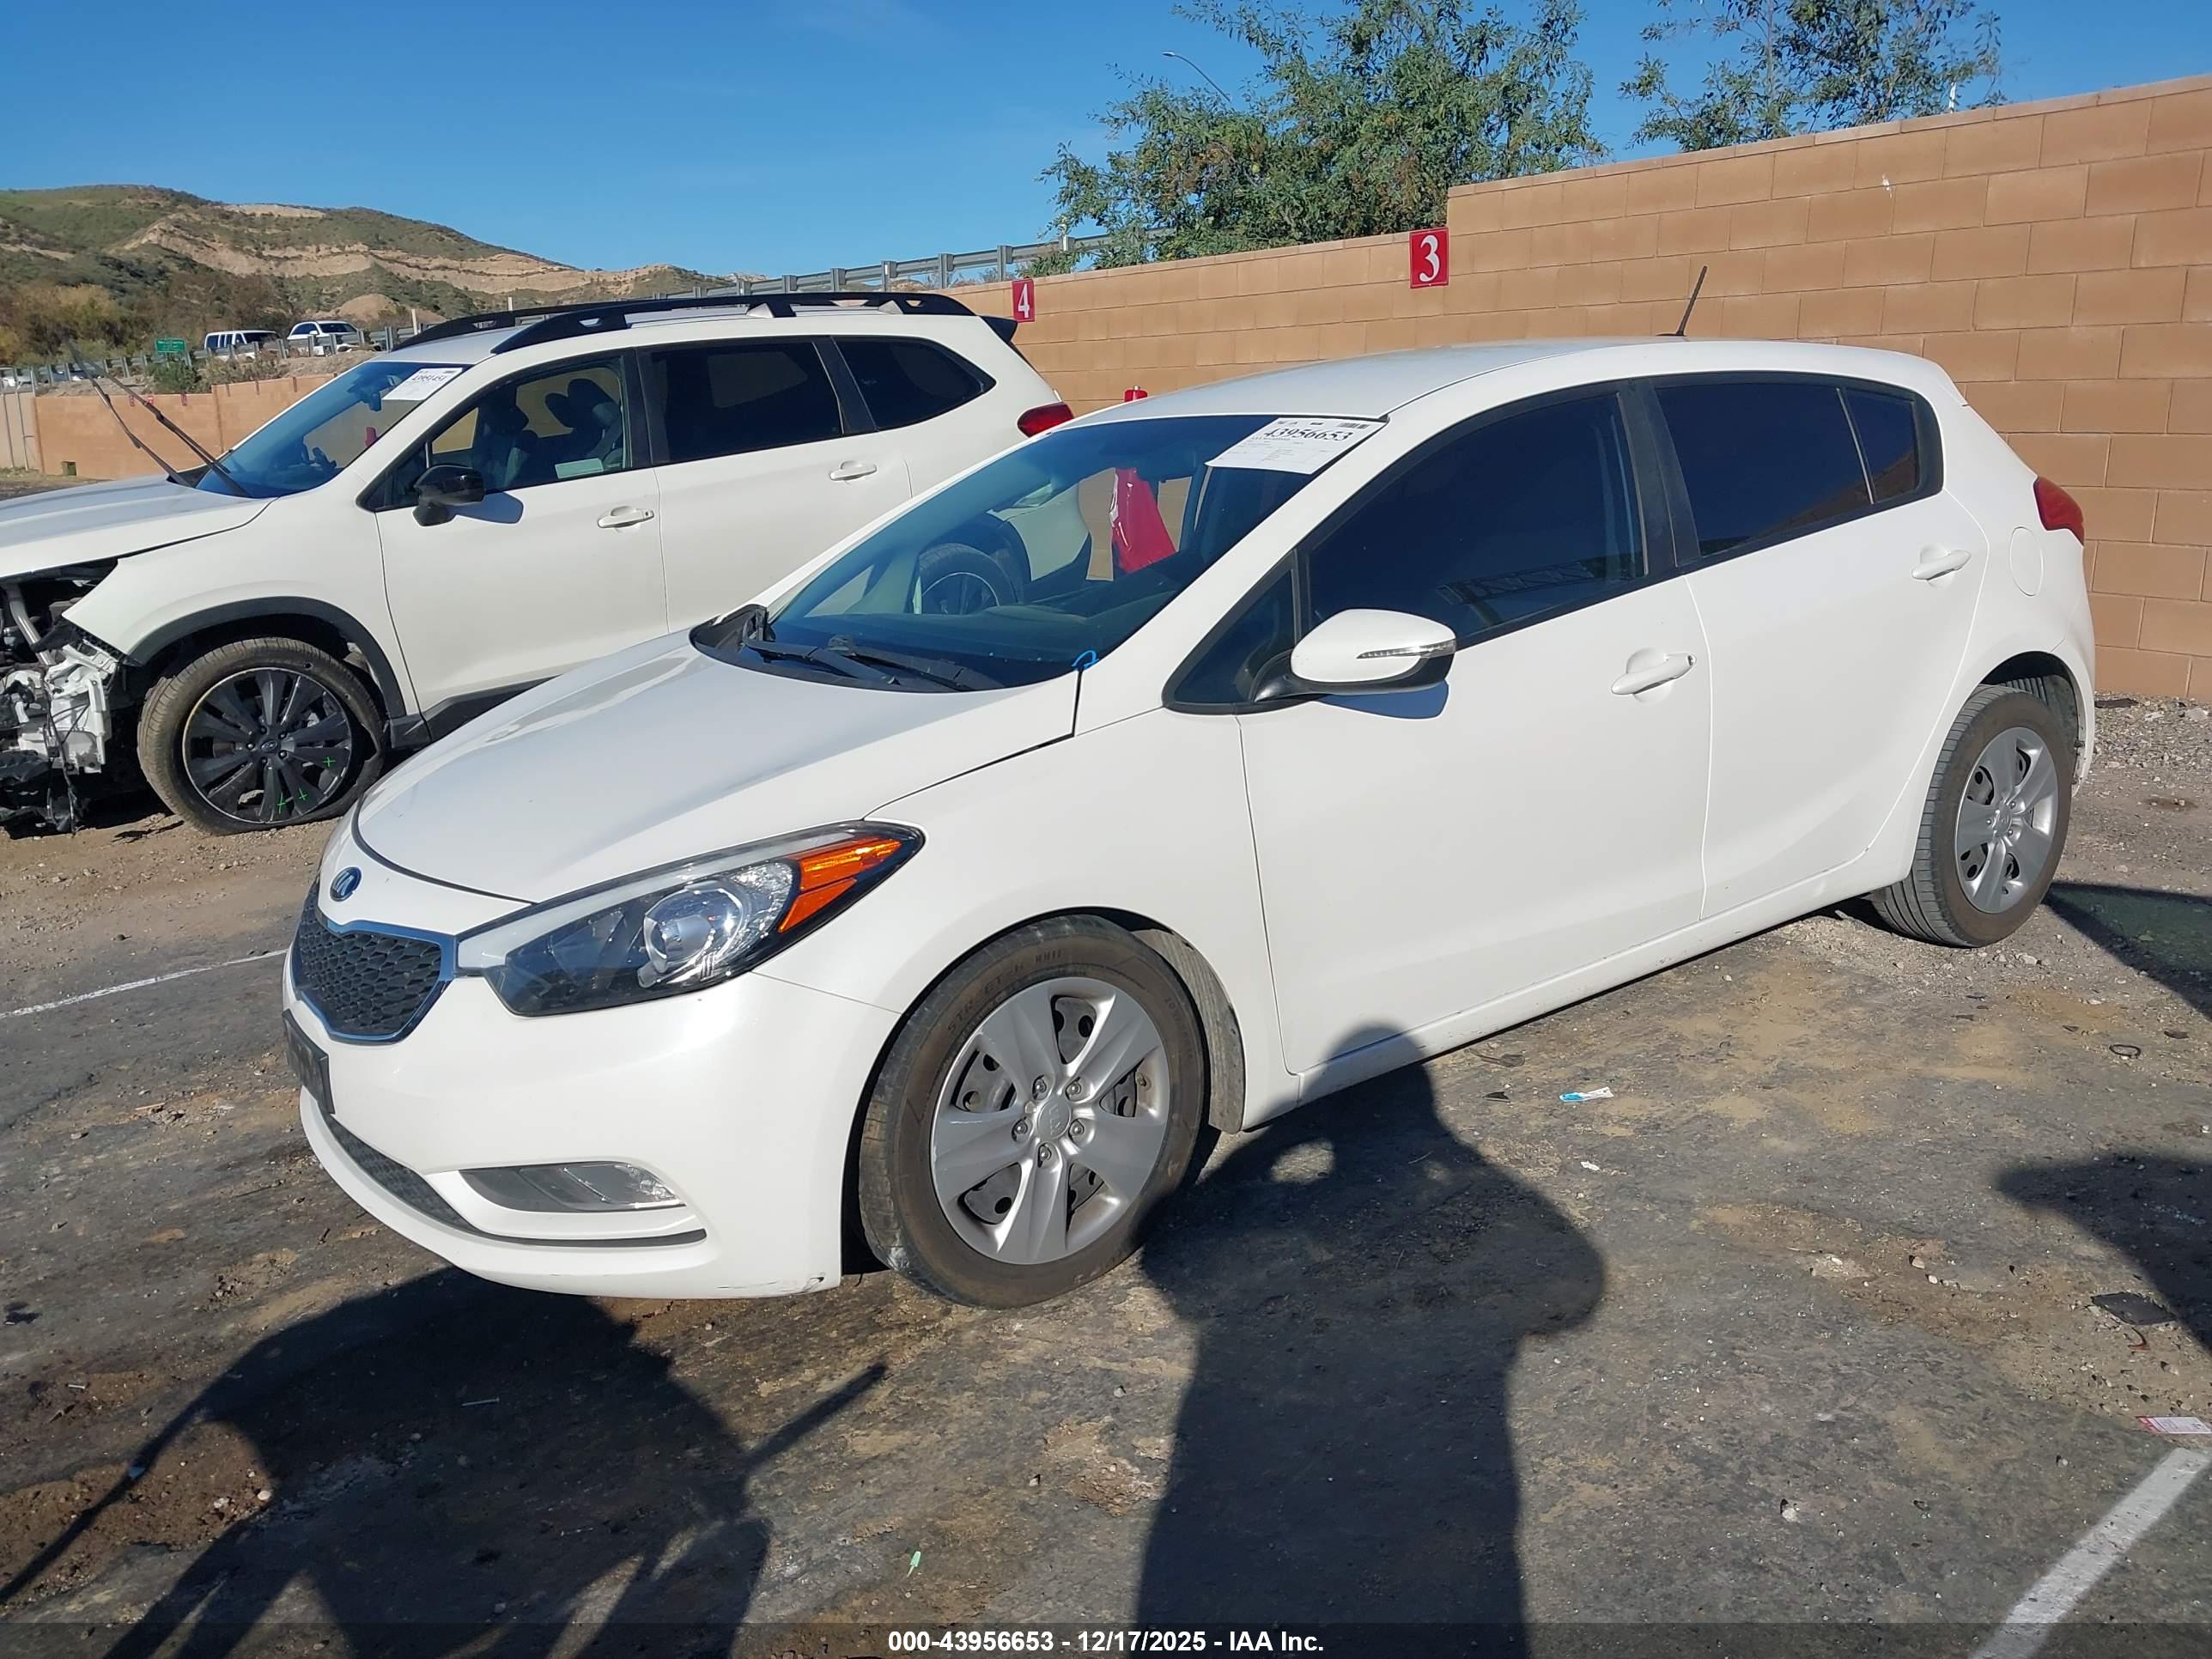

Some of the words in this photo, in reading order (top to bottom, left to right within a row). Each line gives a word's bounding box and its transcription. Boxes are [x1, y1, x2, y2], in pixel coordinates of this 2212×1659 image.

[1419, 234, 1440, 282] 3
[1018, 283, 1030, 319] 4
[1264, 428, 1354, 441] 43956653
